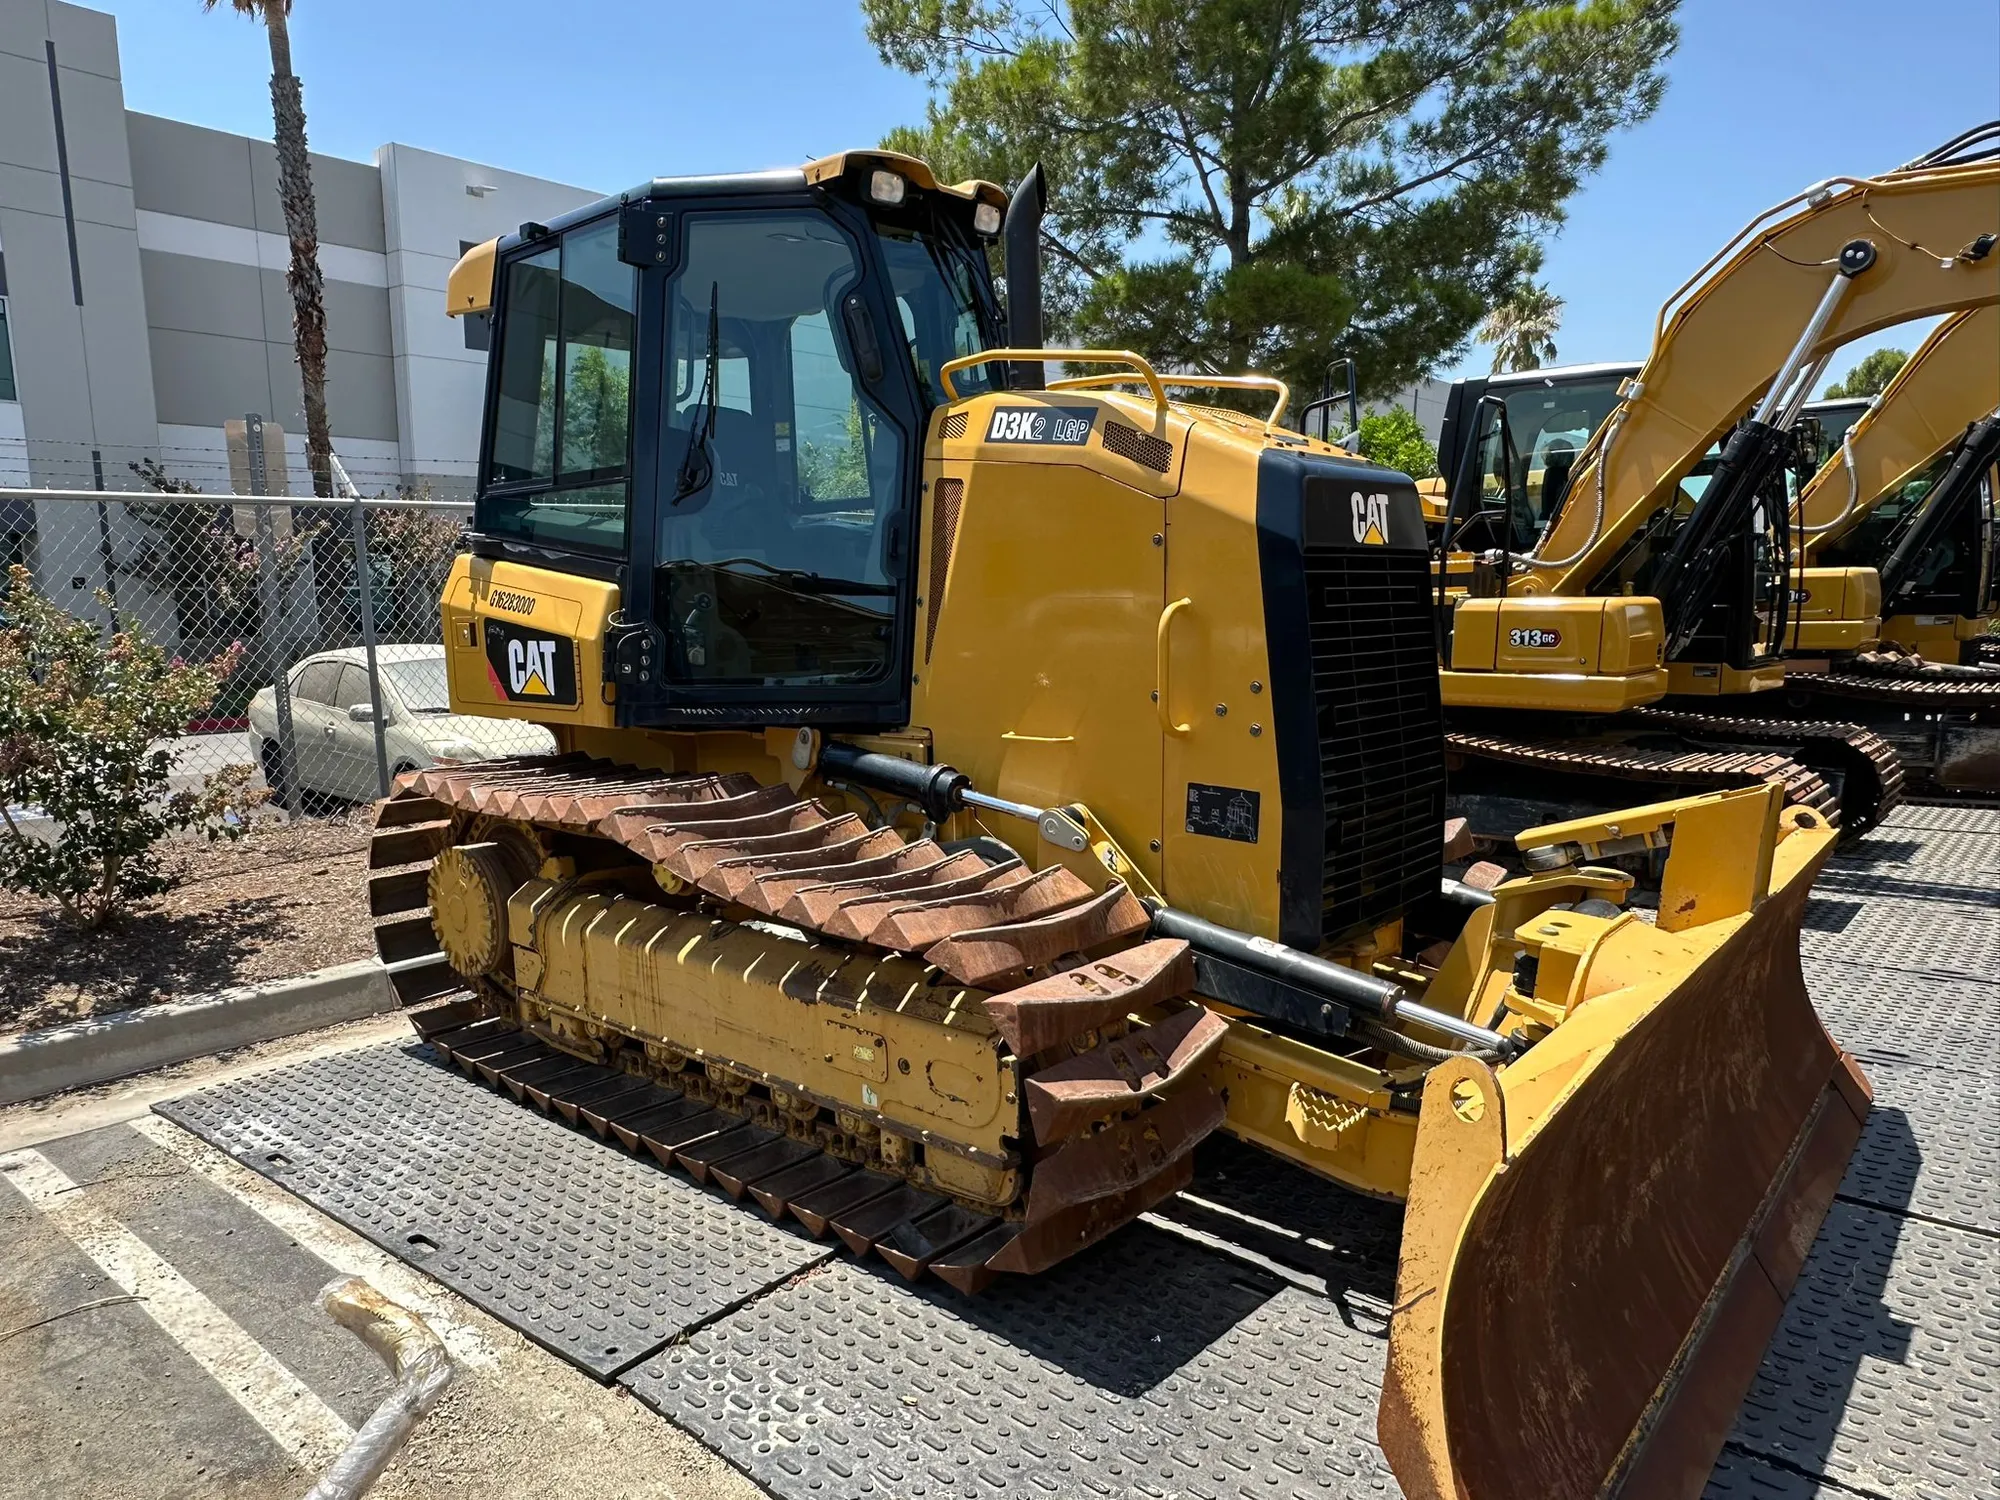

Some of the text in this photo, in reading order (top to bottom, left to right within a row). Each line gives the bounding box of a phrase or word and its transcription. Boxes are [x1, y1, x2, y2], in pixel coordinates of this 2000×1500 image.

[990, 411, 1090, 442] D3K2 LGP
[720, 472, 738, 487] CAT
[1351, 491, 1388, 544] CAT
[508, 639, 556, 696] CAT
